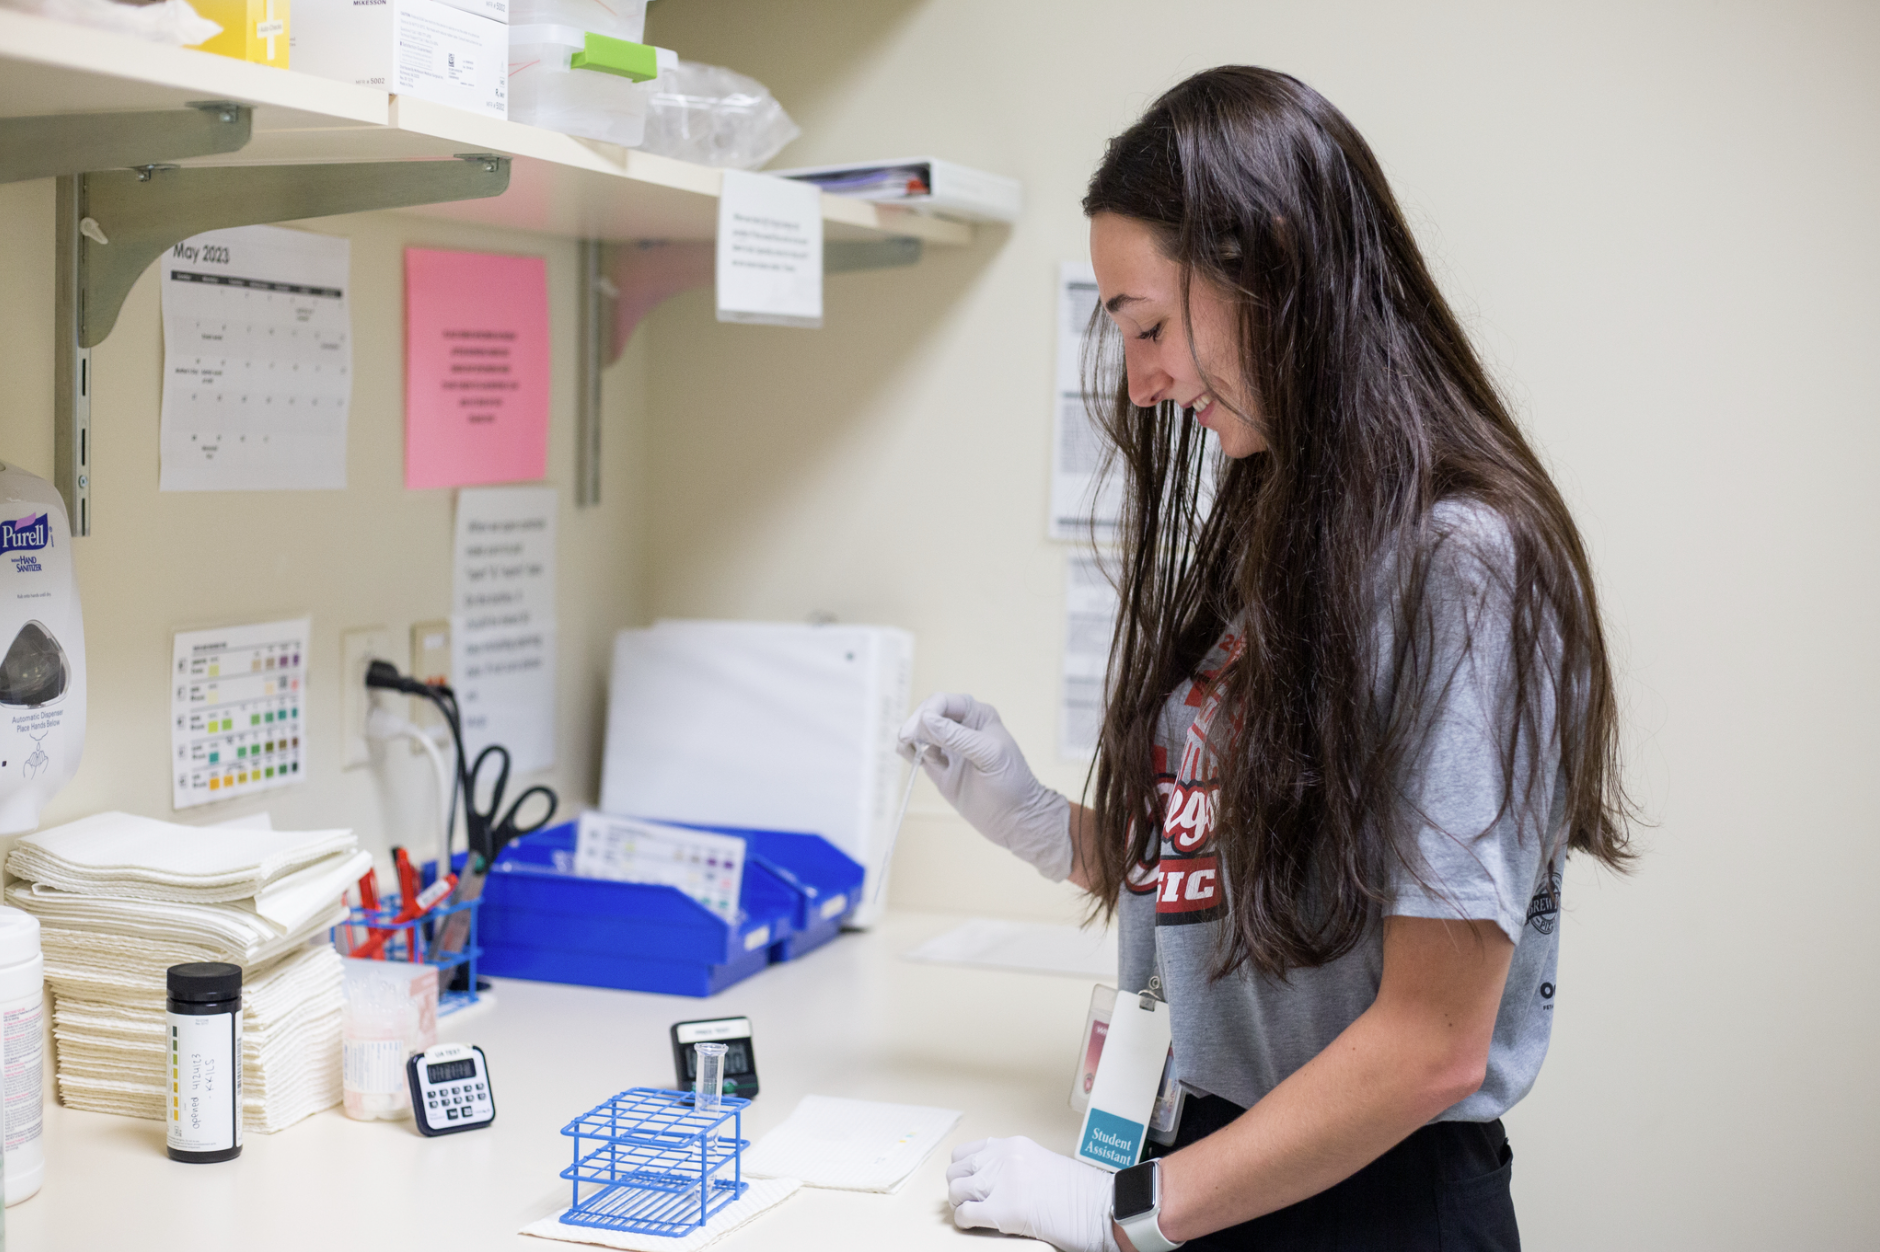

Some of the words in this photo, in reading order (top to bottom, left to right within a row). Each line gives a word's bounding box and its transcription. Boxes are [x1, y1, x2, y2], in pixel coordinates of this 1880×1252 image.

[172, 243, 199, 264] May
[202, 245, 230, 264] 2023
[2, 524, 45, 548] Purell
[16, 563, 42, 573] SANITIZER
[20, 555, 37, 565] HAND
[12, 712, 40, 724] Automatic
[40, 709, 64, 720] Dispenser
[16, 724, 30, 733] Place
[31, 721, 46, 731] Hands
[46, 719, 60, 728] Below
[1091, 1127, 1132, 1151] Student
[1084, 1140, 1131, 1166] Assistant
